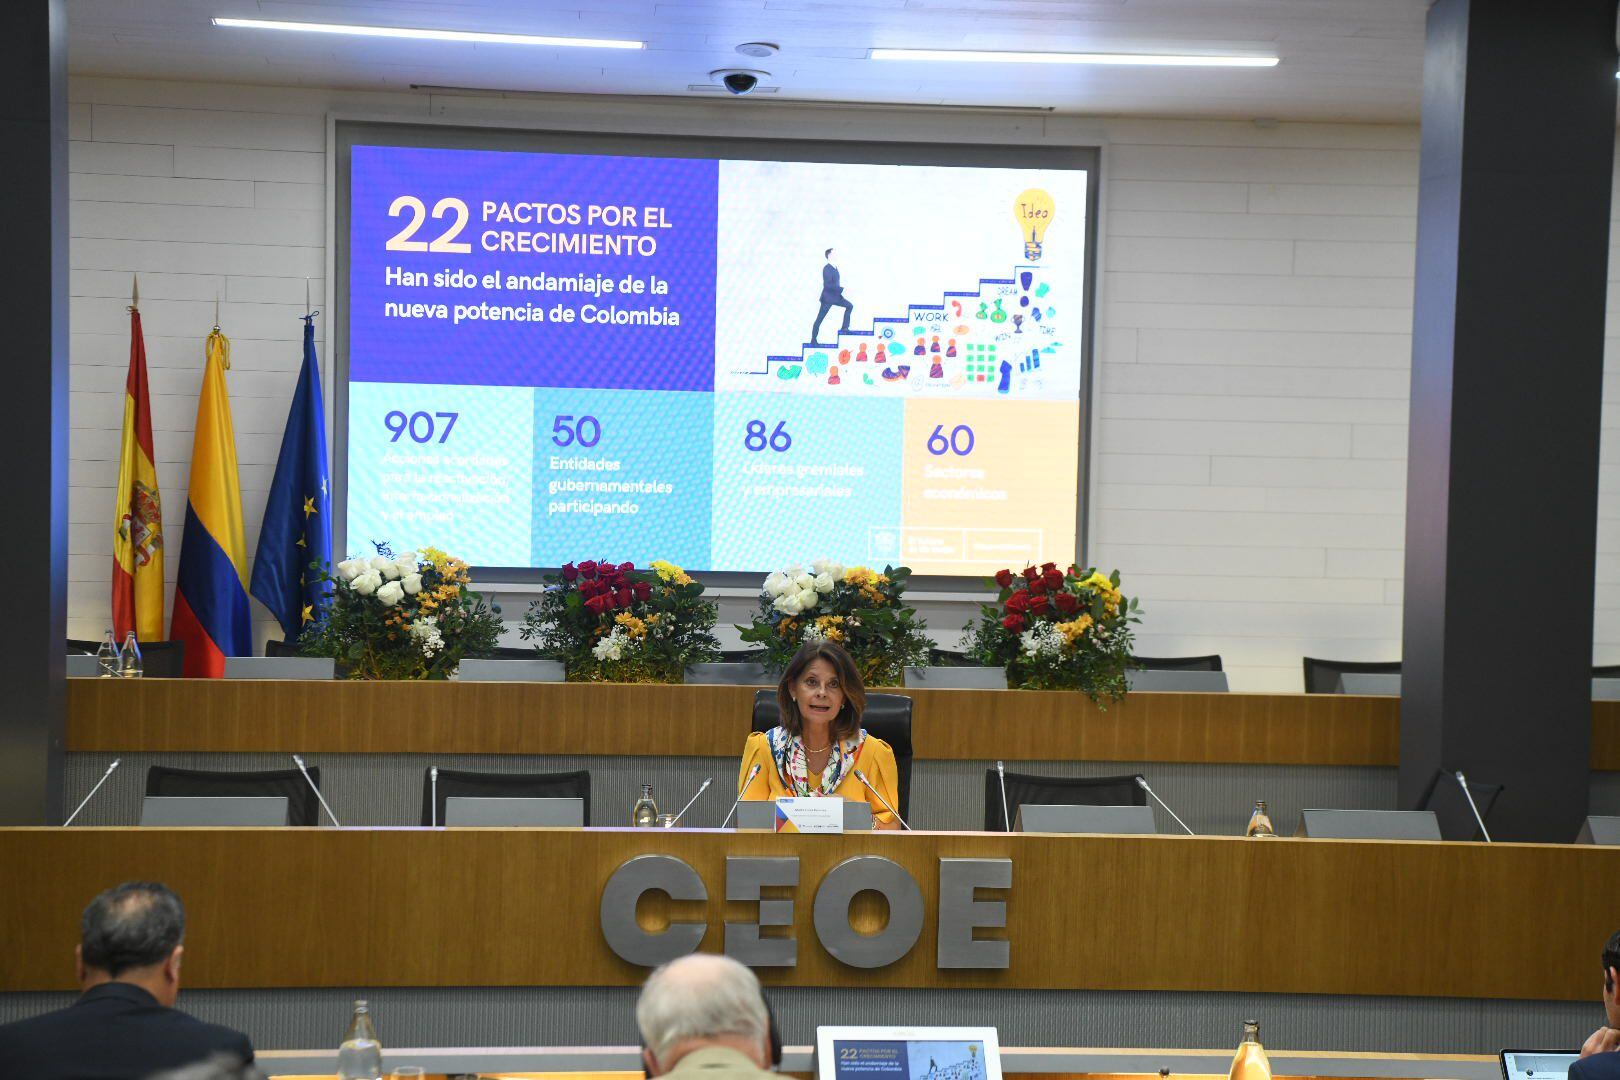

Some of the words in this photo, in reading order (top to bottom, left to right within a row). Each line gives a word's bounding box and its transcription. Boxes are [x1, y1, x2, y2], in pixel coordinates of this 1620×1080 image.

[385, 195, 472, 254] 22
[482, 201, 581, 225] PACTOS
[587, 204, 637, 227] POR
[643, 207, 673, 229] EL
[481, 230, 657, 256] CRECIMIENTO
[385, 267, 429, 287] Han
[433, 268, 477, 289] sido
[482, 270, 502, 290] el
[506, 272, 614, 297] andamiaje
[618, 275, 645, 294] de
[650, 276, 668, 295] la
[384, 301, 448, 319] nueva
[453, 302, 544, 324] potencia
[549, 304, 575, 323] de
[580, 305, 680, 326] Colombia
[913, 312, 949, 322] WORK
[384, 410, 459, 444] 907
[552, 415, 601, 448] 50
[744, 419, 792, 452] 86
[926, 424, 975, 456] 60
[550, 456, 621, 471] Entidades
[549, 478, 673, 495] gubernamentales
[548, 499, 639, 517] participando
[600, 853, 1013, 969] CEOE
[840, 1048, 858, 1060] 22
